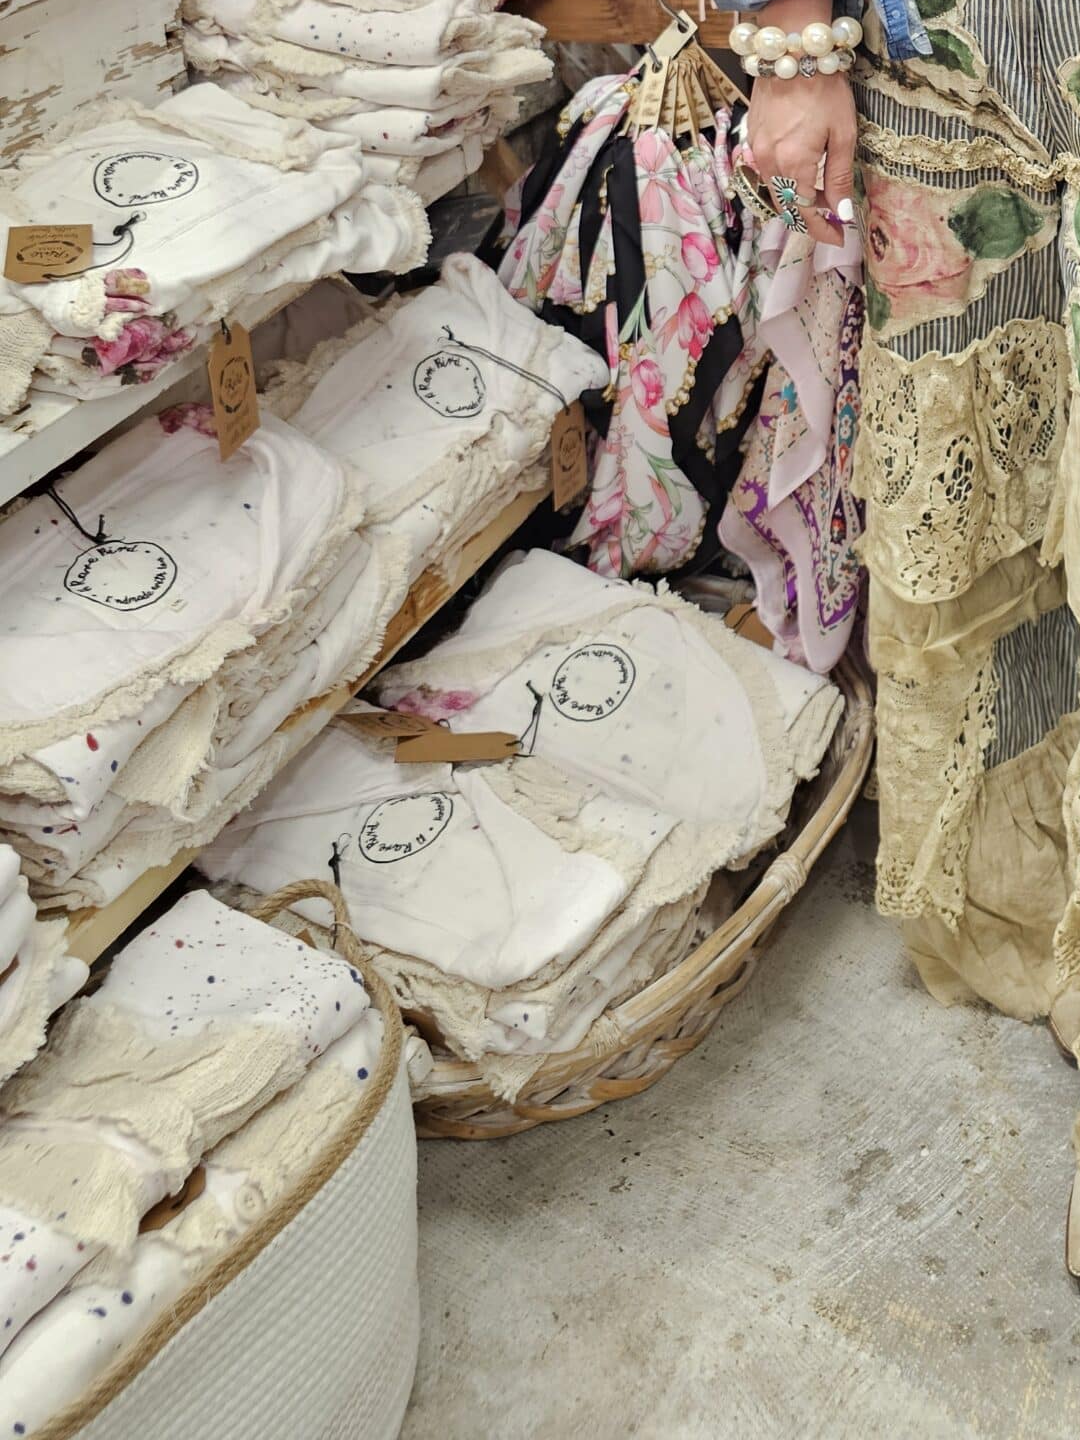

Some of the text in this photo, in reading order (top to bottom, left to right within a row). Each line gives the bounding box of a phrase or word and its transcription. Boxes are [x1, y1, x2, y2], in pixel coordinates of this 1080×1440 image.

[97, 544, 138, 557] Bird
[570, 700, 605, 717] Rare
[378, 842, 413, 855] Rare
